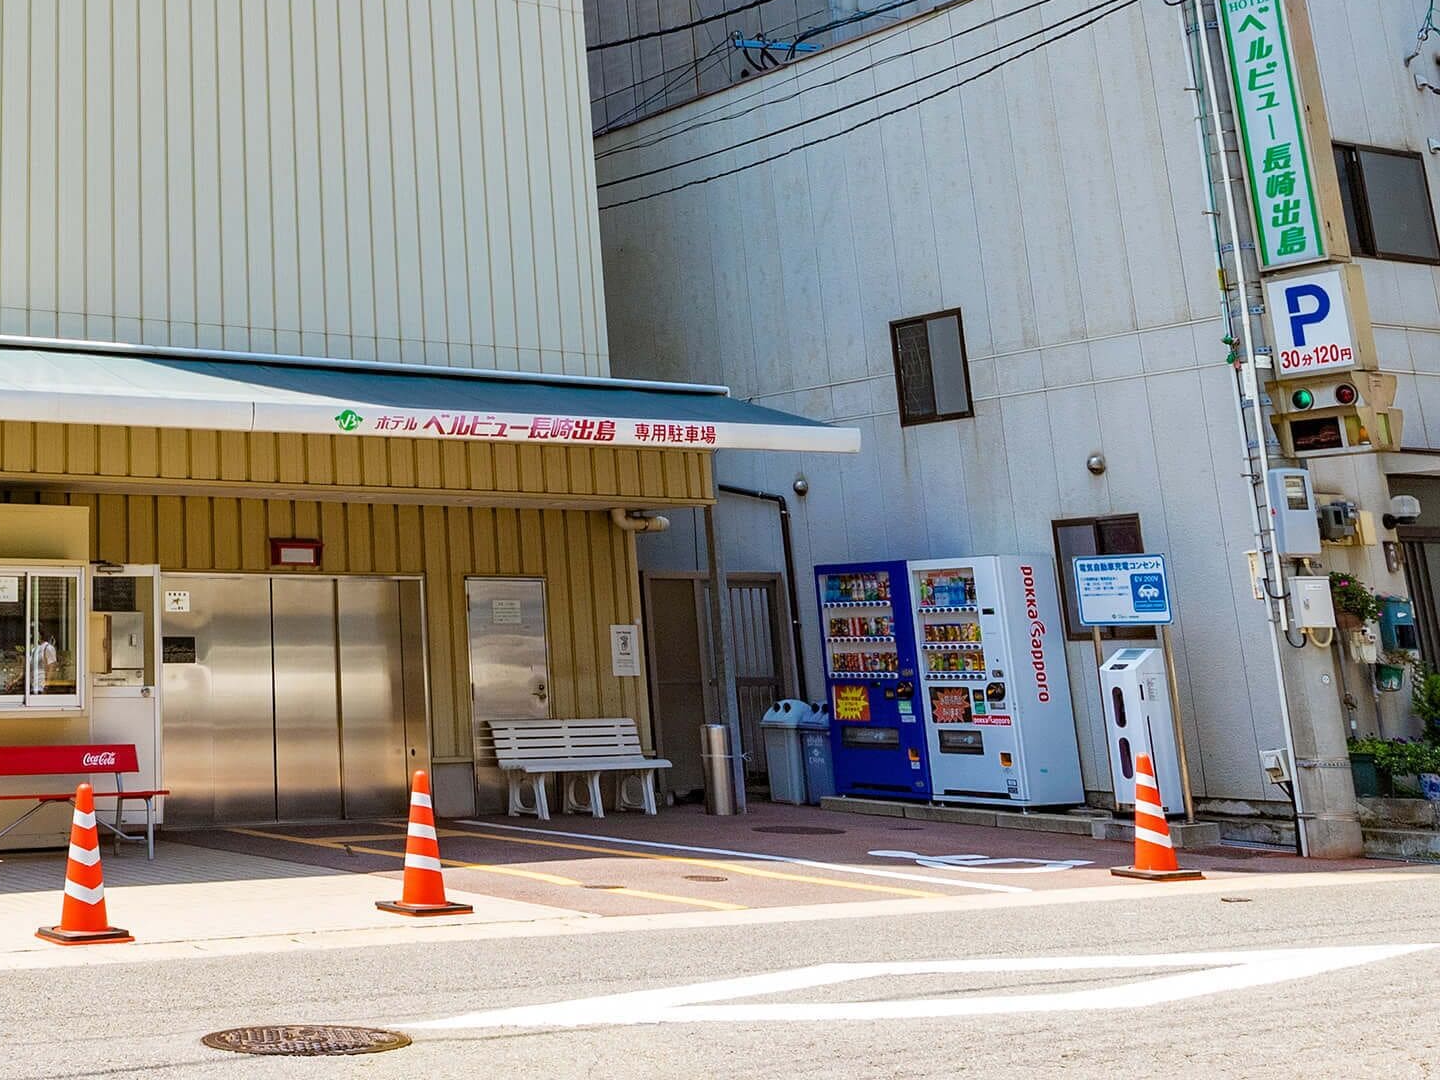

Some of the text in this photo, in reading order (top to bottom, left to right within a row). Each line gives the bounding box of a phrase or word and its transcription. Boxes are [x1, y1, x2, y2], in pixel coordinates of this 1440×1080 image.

[1238, 6, 1307, 257] ベルビュー長崎出島
[1285, 283, 1331, 348] P
[1280, 343, 1352, 374] 30分120円
[375, 414, 717, 445] ホテル ベルビュー長崎出島 専用駐車場
